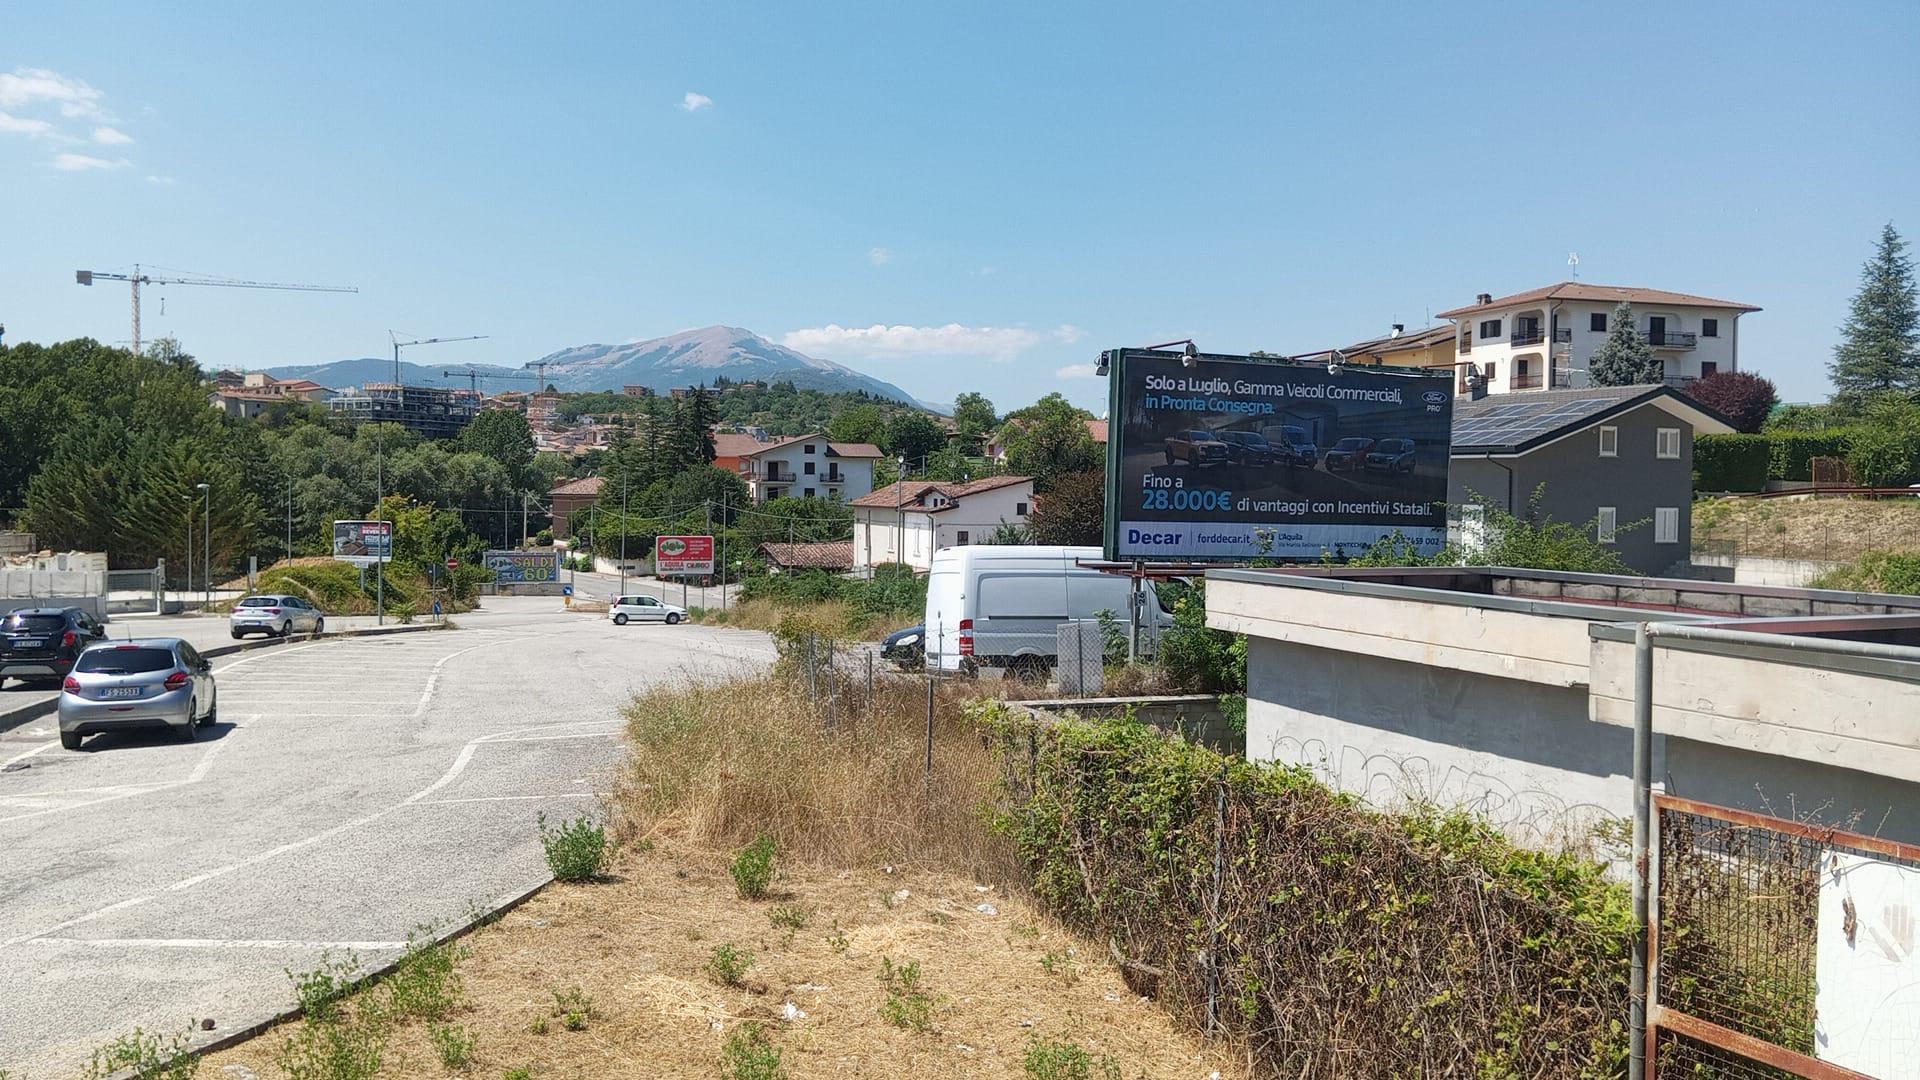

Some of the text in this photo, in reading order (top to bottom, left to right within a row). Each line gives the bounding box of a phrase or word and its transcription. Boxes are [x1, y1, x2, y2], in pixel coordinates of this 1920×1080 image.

[1145, 375, 1403, 405] Solo a Luglio, Gamma Veicoli Commerciali,
[1145, 393, 1275, 416] in Pronta Consegna.
[1426, 404, 1441, 412] PRO
[1142, 473, 1183, 488] Fino a
[1142, 489, 1232, 511] 28.000€
[1236, 497, 1433, 516] di vantaggi con Incentivi Statali.
[1128, 529, 1183, 545] Decar
[1197, 533, 1251, 544] forddecar.it
[1425, 537, 1440, 546] 002
[513, 556, 556, 568] SALDI
[1138, 592, 1146, 605] 26
